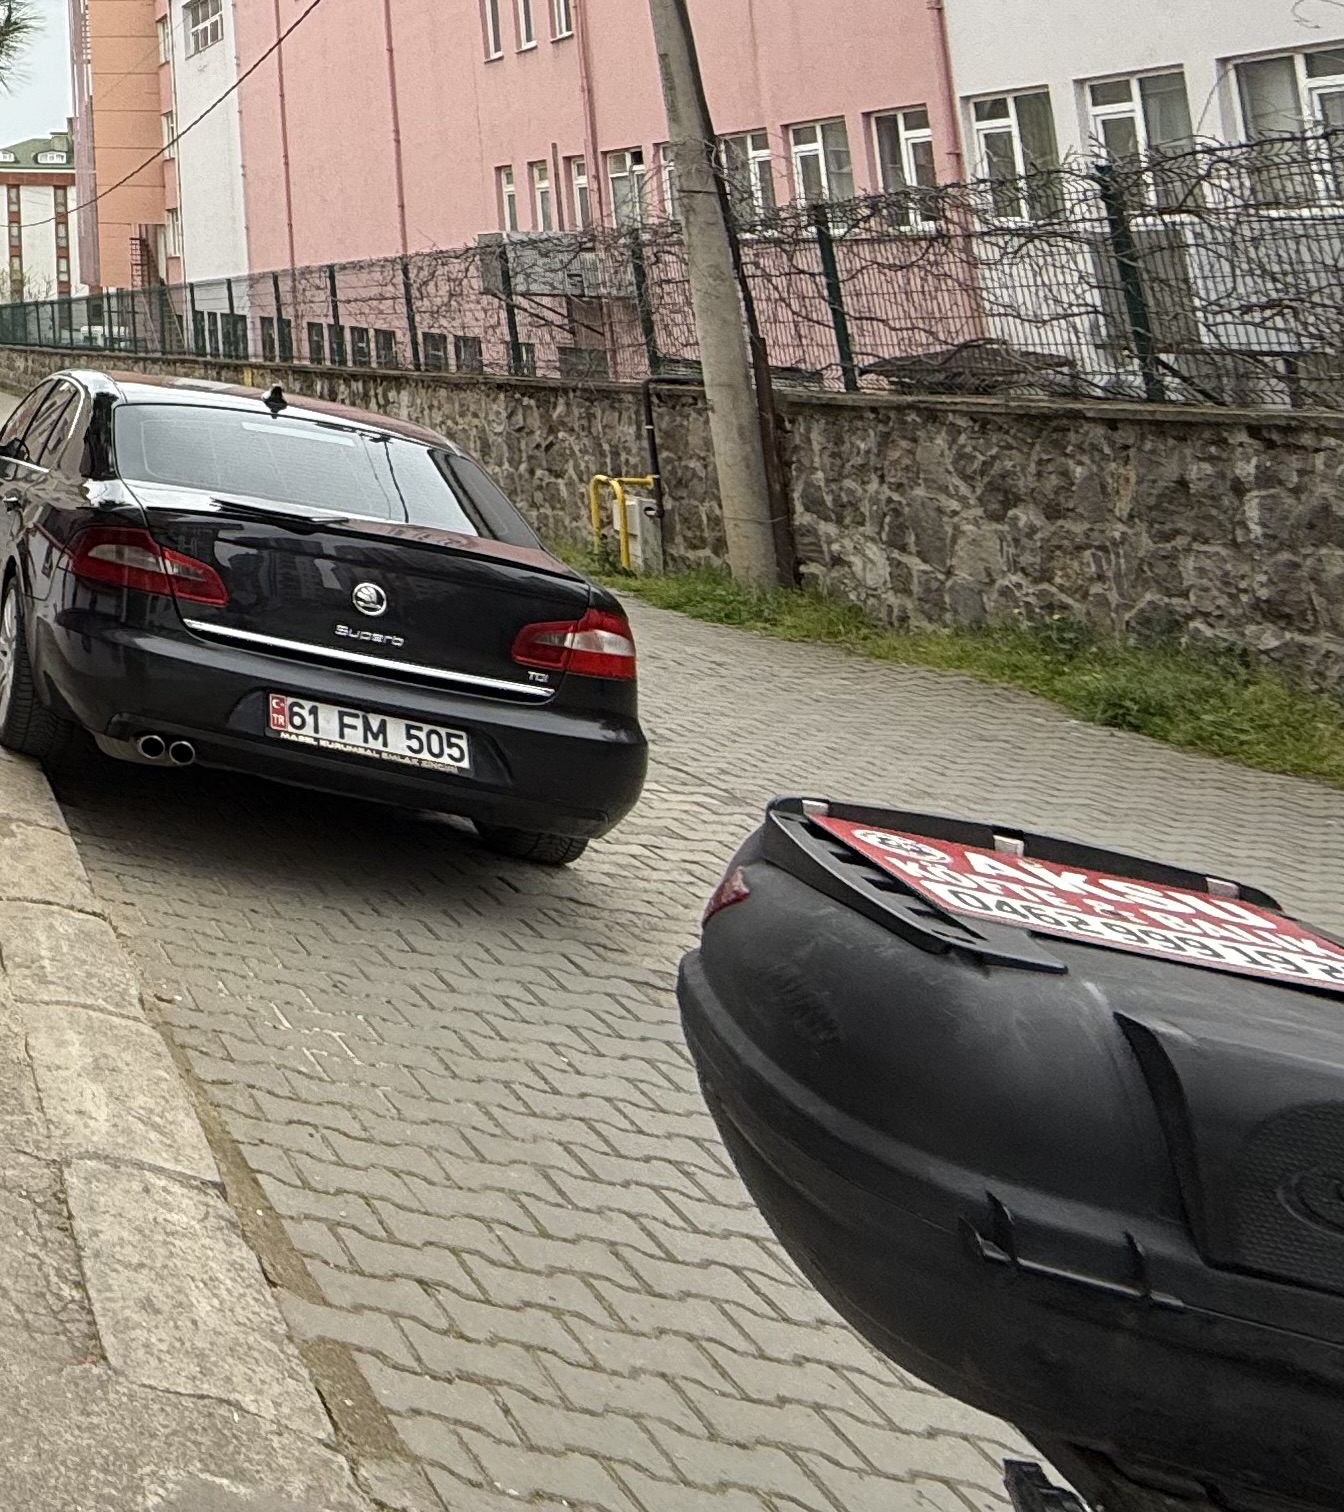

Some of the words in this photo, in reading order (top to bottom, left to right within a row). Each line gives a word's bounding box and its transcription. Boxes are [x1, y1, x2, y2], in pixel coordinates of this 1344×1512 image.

[334, 624, 405, 647] Superb
[272, 713, 285, 727] TR
[288, 701, 320, 735] 61
[338, 710, 388, 749] FM
[405, 723, 466, 764] 505
[884, 856, 1082, 911] KÖFTE
[1082, 898, 1148, 925] &
[1140, 908, 1344, 962] BALIK
[964, 851, 1277, 929] AKSU
[947, 889, 1104, 935] 0462
[1102, 921, 1226, 960] 999
[1217, 944, 1309, 975] 19
